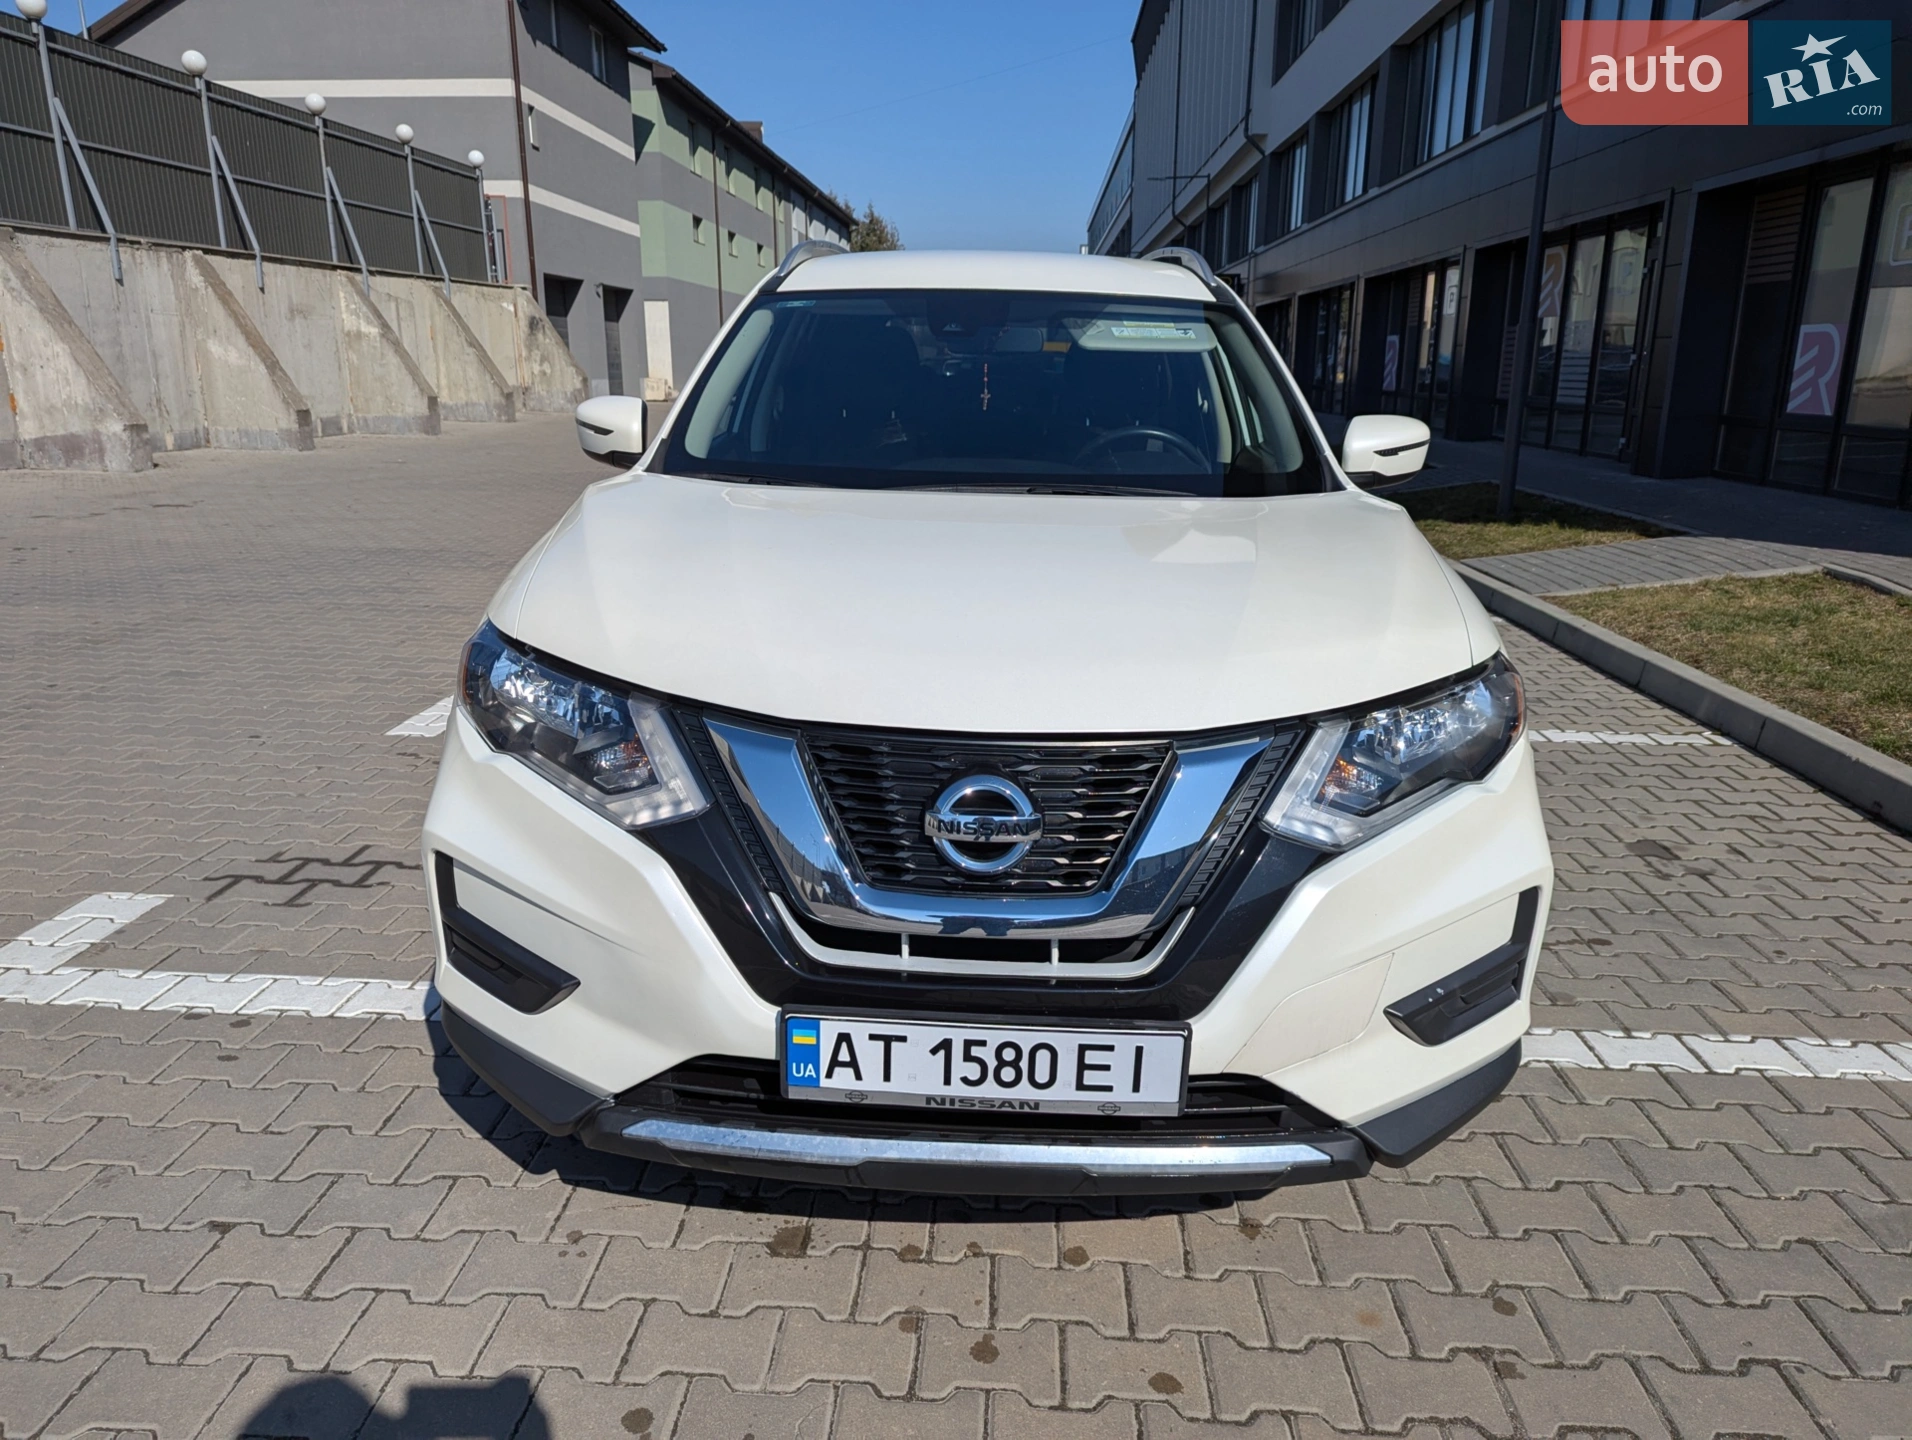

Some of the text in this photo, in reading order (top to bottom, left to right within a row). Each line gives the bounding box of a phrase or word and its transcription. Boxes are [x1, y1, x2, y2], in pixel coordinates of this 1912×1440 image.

[937, 819, 1030, 837] NISSAN
[792, 1061, 817, 1079] UA
[824, 1031, 1144, 1093] AT 1580 EI
[925, 1096, 1040, 1111] NISSAN
